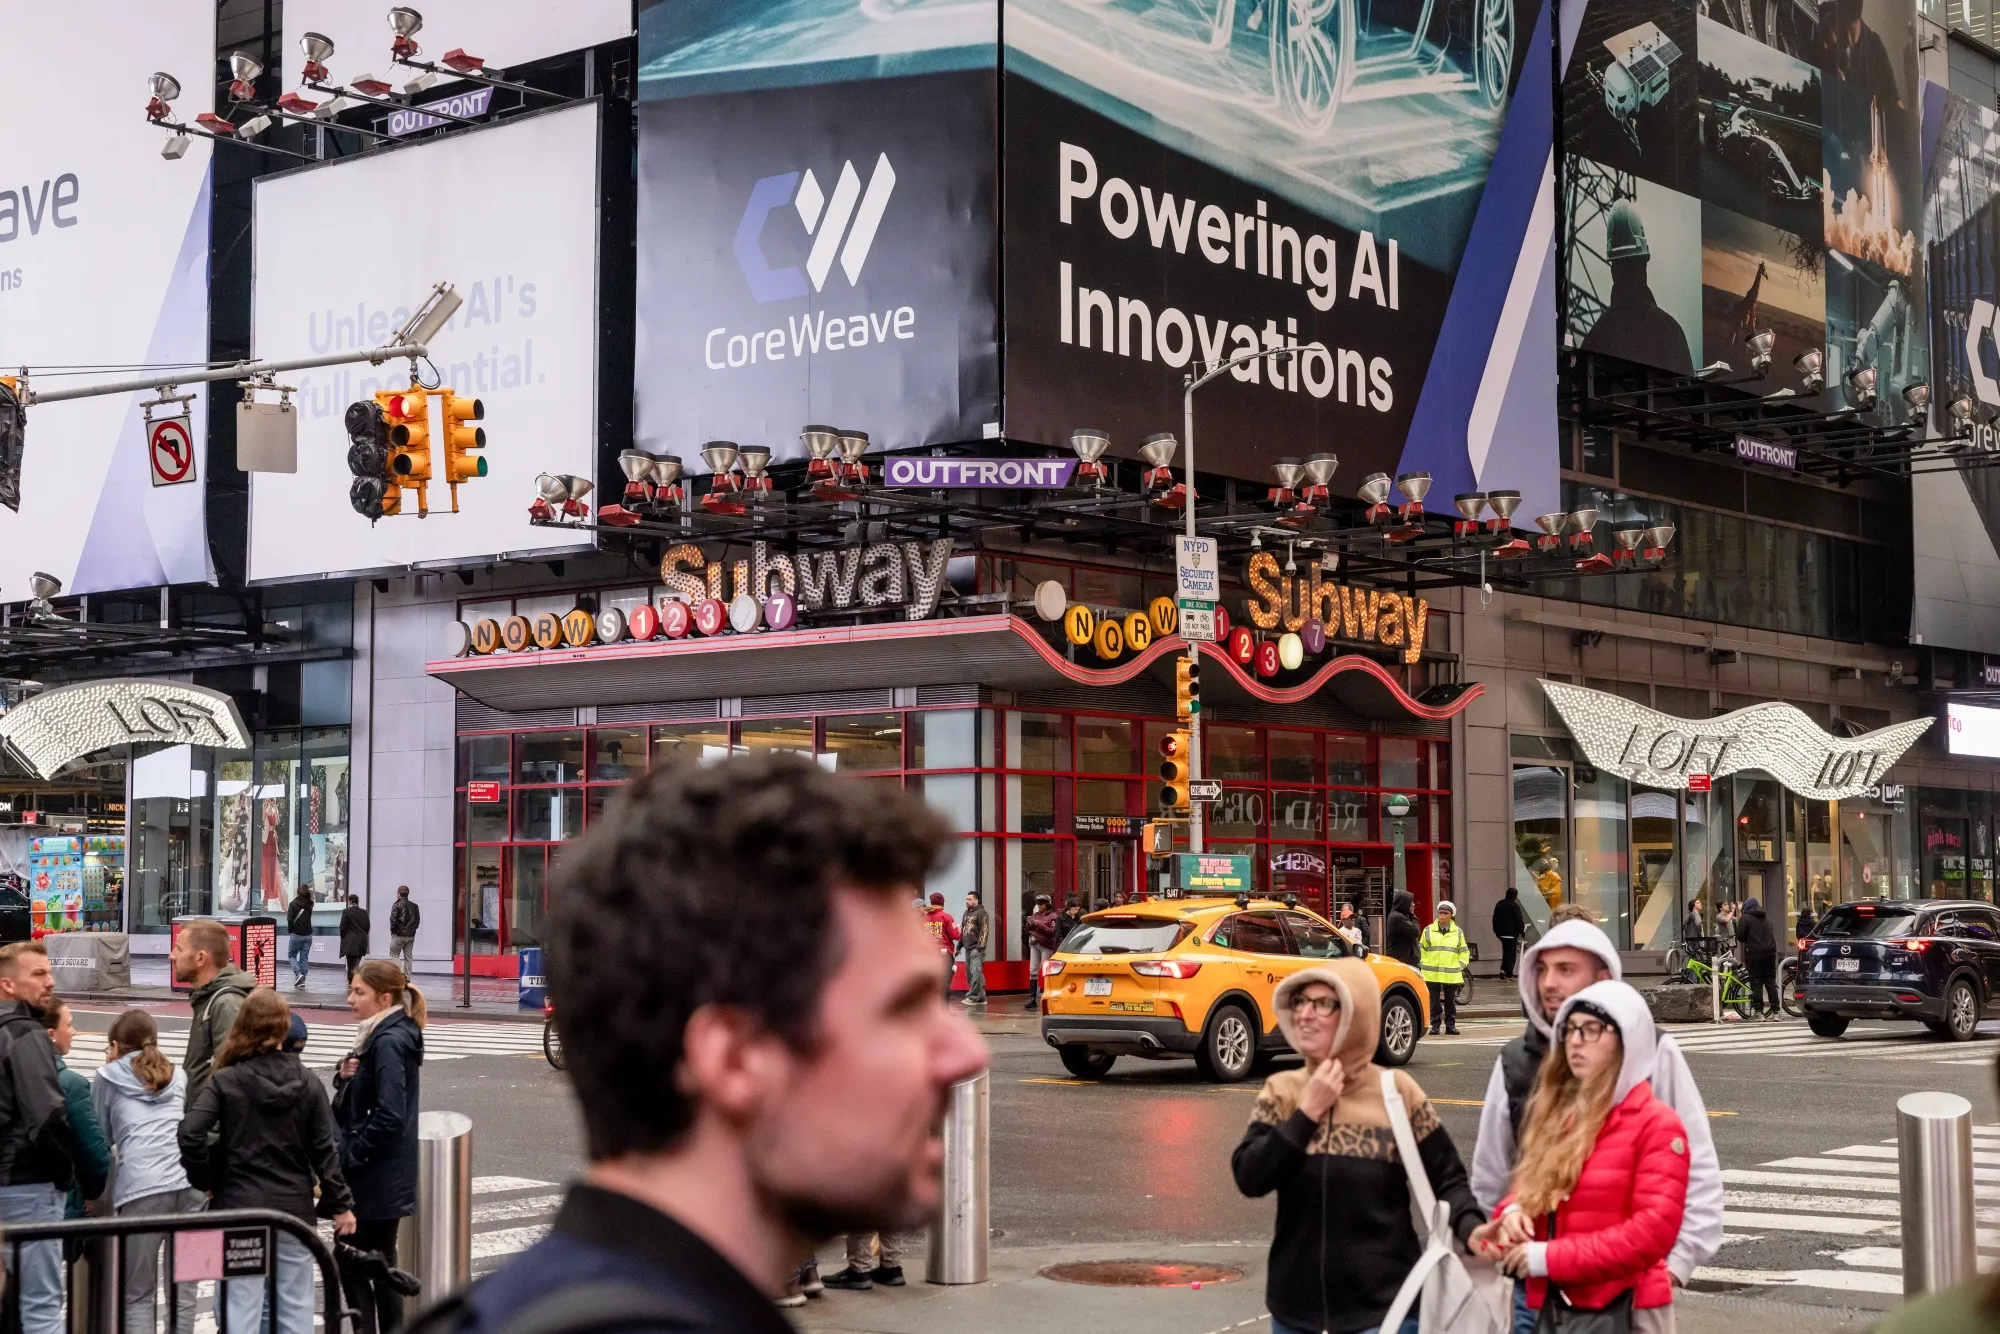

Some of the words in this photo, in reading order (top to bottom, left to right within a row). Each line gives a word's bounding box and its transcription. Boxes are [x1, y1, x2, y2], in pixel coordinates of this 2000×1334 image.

[391, 92, 487, 133] OUTFRONT
[0, 172, 79, 243] ave
[1060, 141, 1336, 311] Powering
[1349, 230, 1399, 310] AI
[309, 301, 454, 354] Unlea
[464, 275, 537, 329] AI's
[705, 306, 915, 369] CoreWeave
[1060, 261, 1393, 412] Innovations
[298, 370, 350, 421] full
[360, 338, 546, 402] poential.
[892, 460, 1066, 485] OUTFRONT
[1739, 439, 1793, 467] OUTFRONT
[1183, 540, 1209, 553] NYPD
[661, 539, 953, 620] Subway
[1180, 566, 1214, 579] SECURITY
[1182, 578, 1213, 591] CAMERA
[477, 624, 491, 647] N
[507, 620, 521, 644] Q
[538, 618, 552, 642] R
[567, 617, 587, 643] W
[601, 613, 616, 637] S
[636, 610, 647, 634] 1
[668, 608, 682, 632] 2
[701, 604, 715, 630] 3
[771, 598, 785, 623] 7
[1248, 552, 1428, 664] Subway
[1076, 612, 1089, 638] N
[1105, 626, 1119, 653] Q
[1134, 618, 1147, 643] R
[1157, 604, 1175, 631] W
[1217, 611, 1224, 635] 1
[1240, 633, 1251, 658] 2
[1265, 646, 1276, 671] 3
[1312, 624, 1321, 647] 7
[104, 697, 229, 744] LOFT
[1619, 724, 1741, 782] LOFT
[1814, 749, 1888, 789] LOFT
[1191, 786, 1201, 794] ONE
[65, 958, 89, 967] SQUARE
